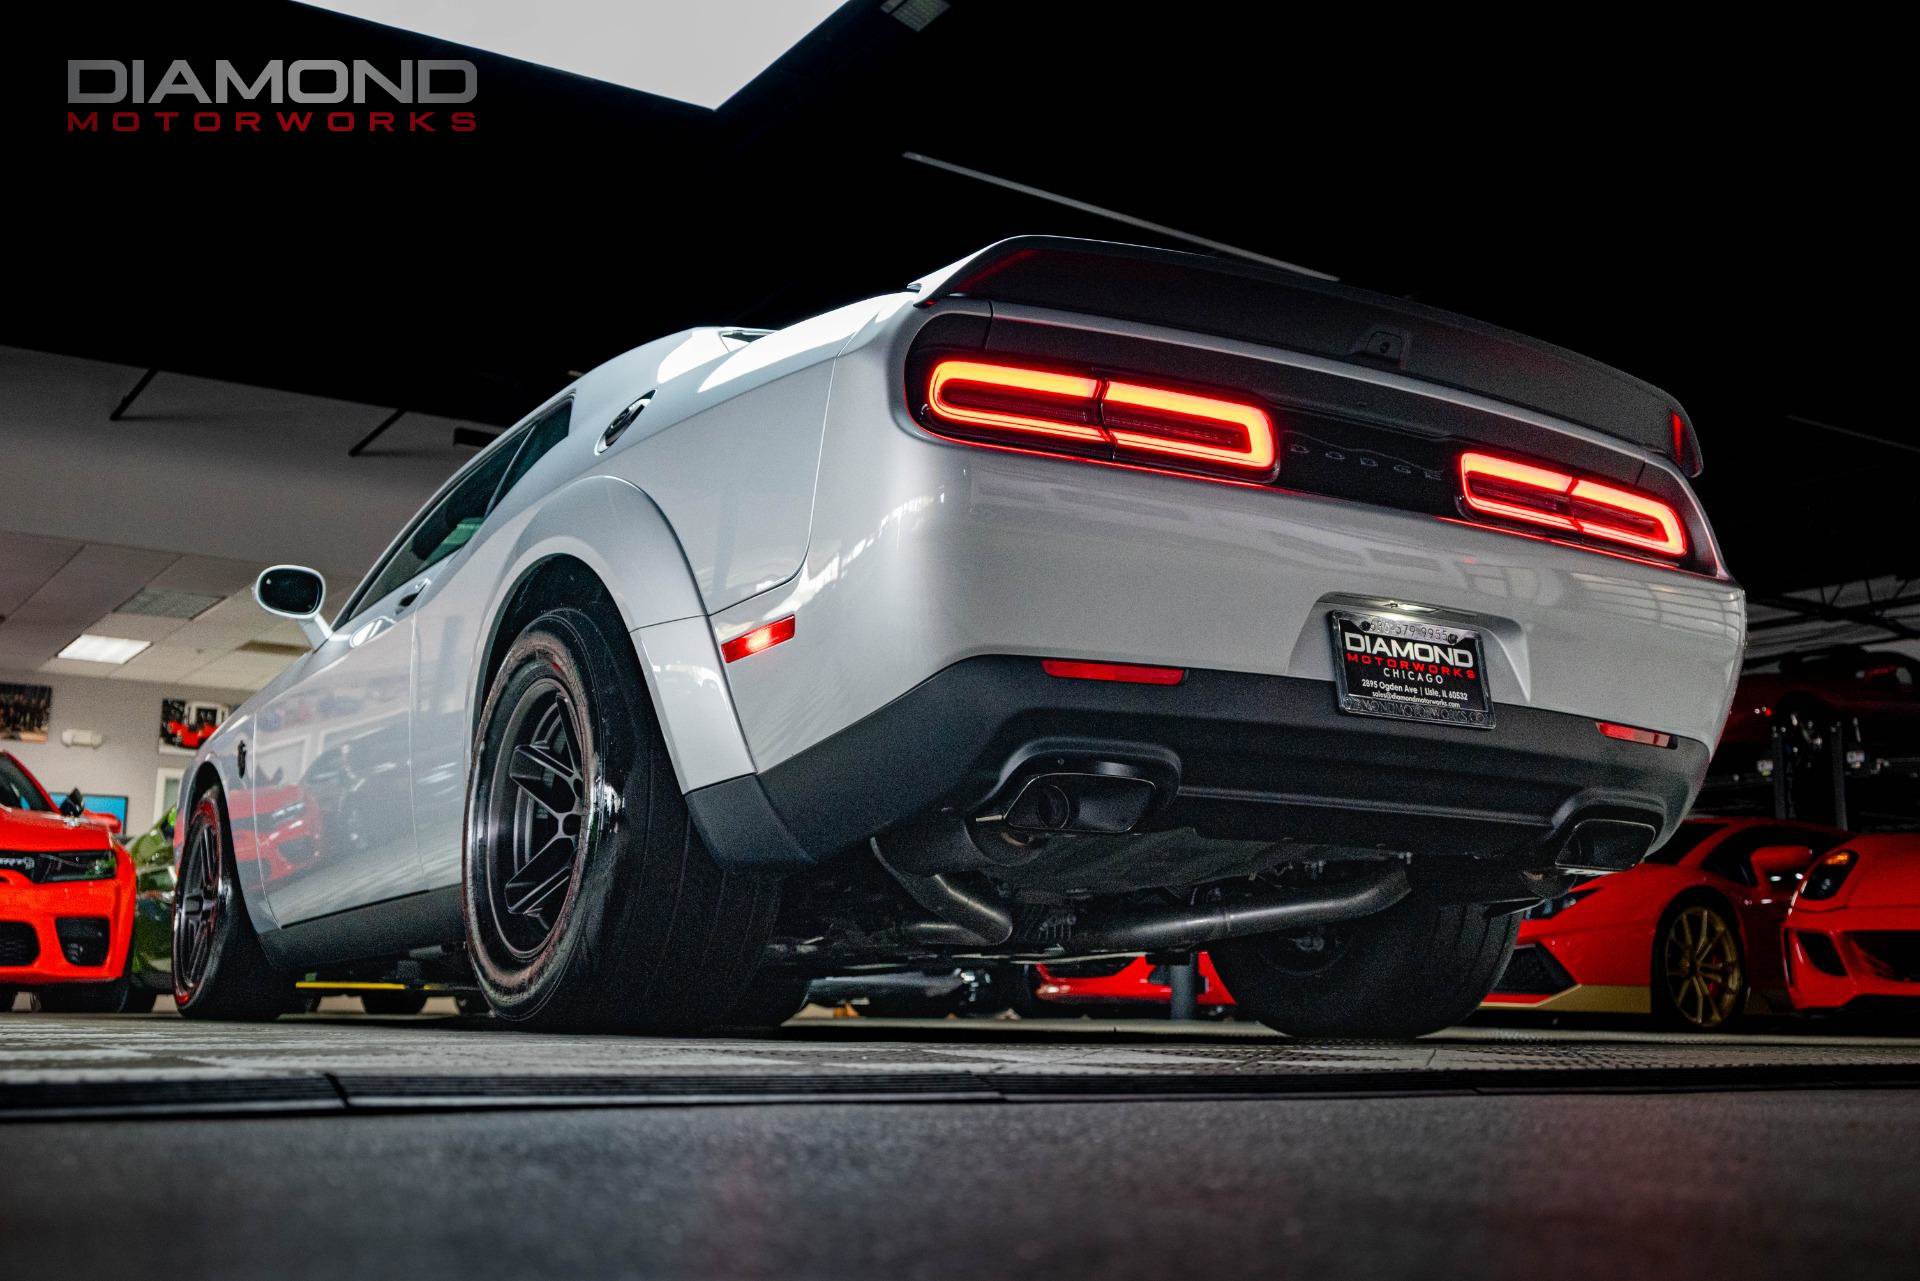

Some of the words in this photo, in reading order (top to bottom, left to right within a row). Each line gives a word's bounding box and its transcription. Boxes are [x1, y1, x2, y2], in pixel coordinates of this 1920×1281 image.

[1290, 444, 1443, 481] DODGE
[1344, 631, 1474, 668] DIAMOND
[1346, 652, 1476, 679] MOTORWORKS
[1383, 667, 1444, 684] CHICAGO
[1361, 678, 1378, 688] 2895
[1379, 681, 1403, 692] Ogden
[1404, 685, 1418, 694] Ave
[1425, 687, 1441, 697] Lisle,
[1448, 690, 1468, 700] 60532
[1372, 690, 1461, 708] sales@diamondmotorworks.com
